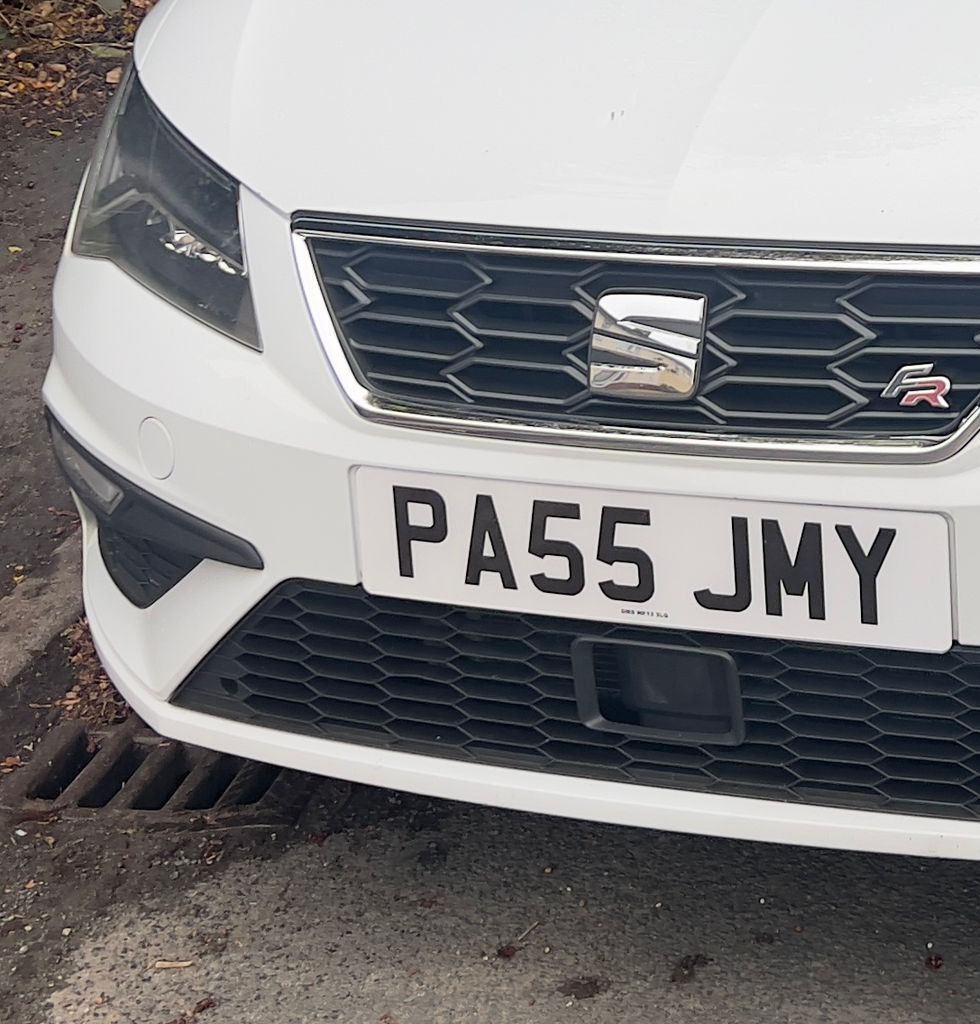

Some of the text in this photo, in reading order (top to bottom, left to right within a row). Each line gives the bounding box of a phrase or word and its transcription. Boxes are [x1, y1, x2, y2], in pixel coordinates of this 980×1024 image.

[880, 363, 951, 408] FR
[392, 484, 897, 625] PA55 JMY
